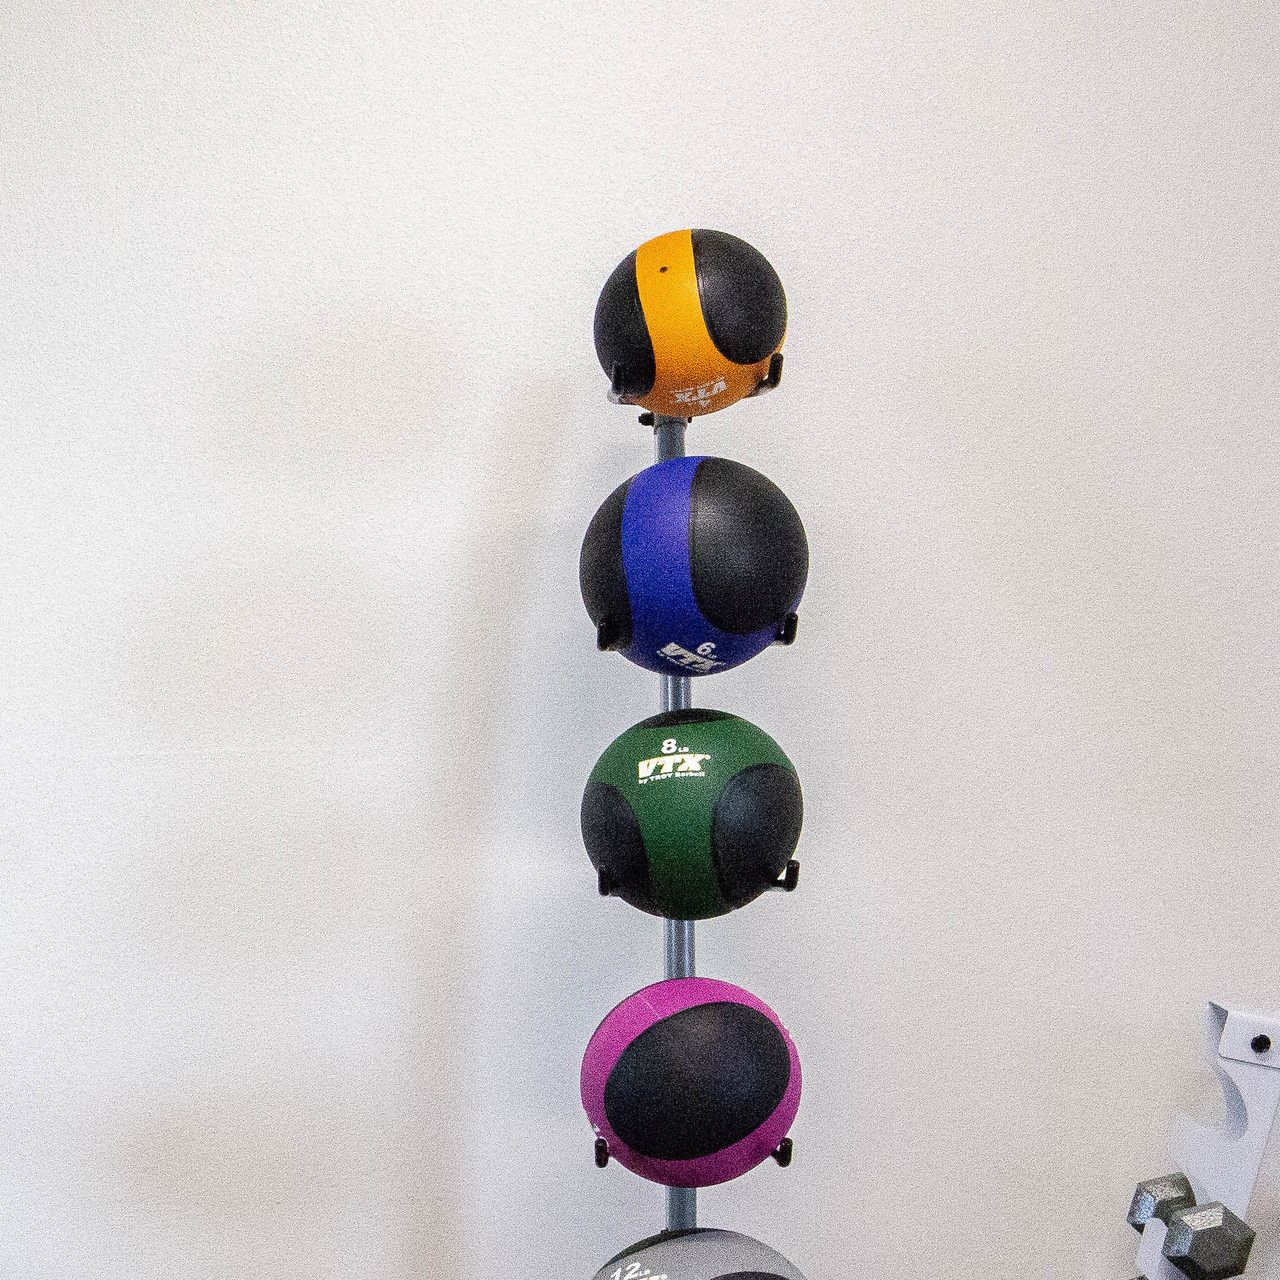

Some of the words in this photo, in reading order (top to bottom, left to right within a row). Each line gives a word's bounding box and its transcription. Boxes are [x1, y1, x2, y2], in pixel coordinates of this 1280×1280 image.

[661, 642, 720, 671] VTX
[696, 642, 716, 656] 6
[661, 738, 678, 754] 8
[638, 753, 706, 779] VTX
